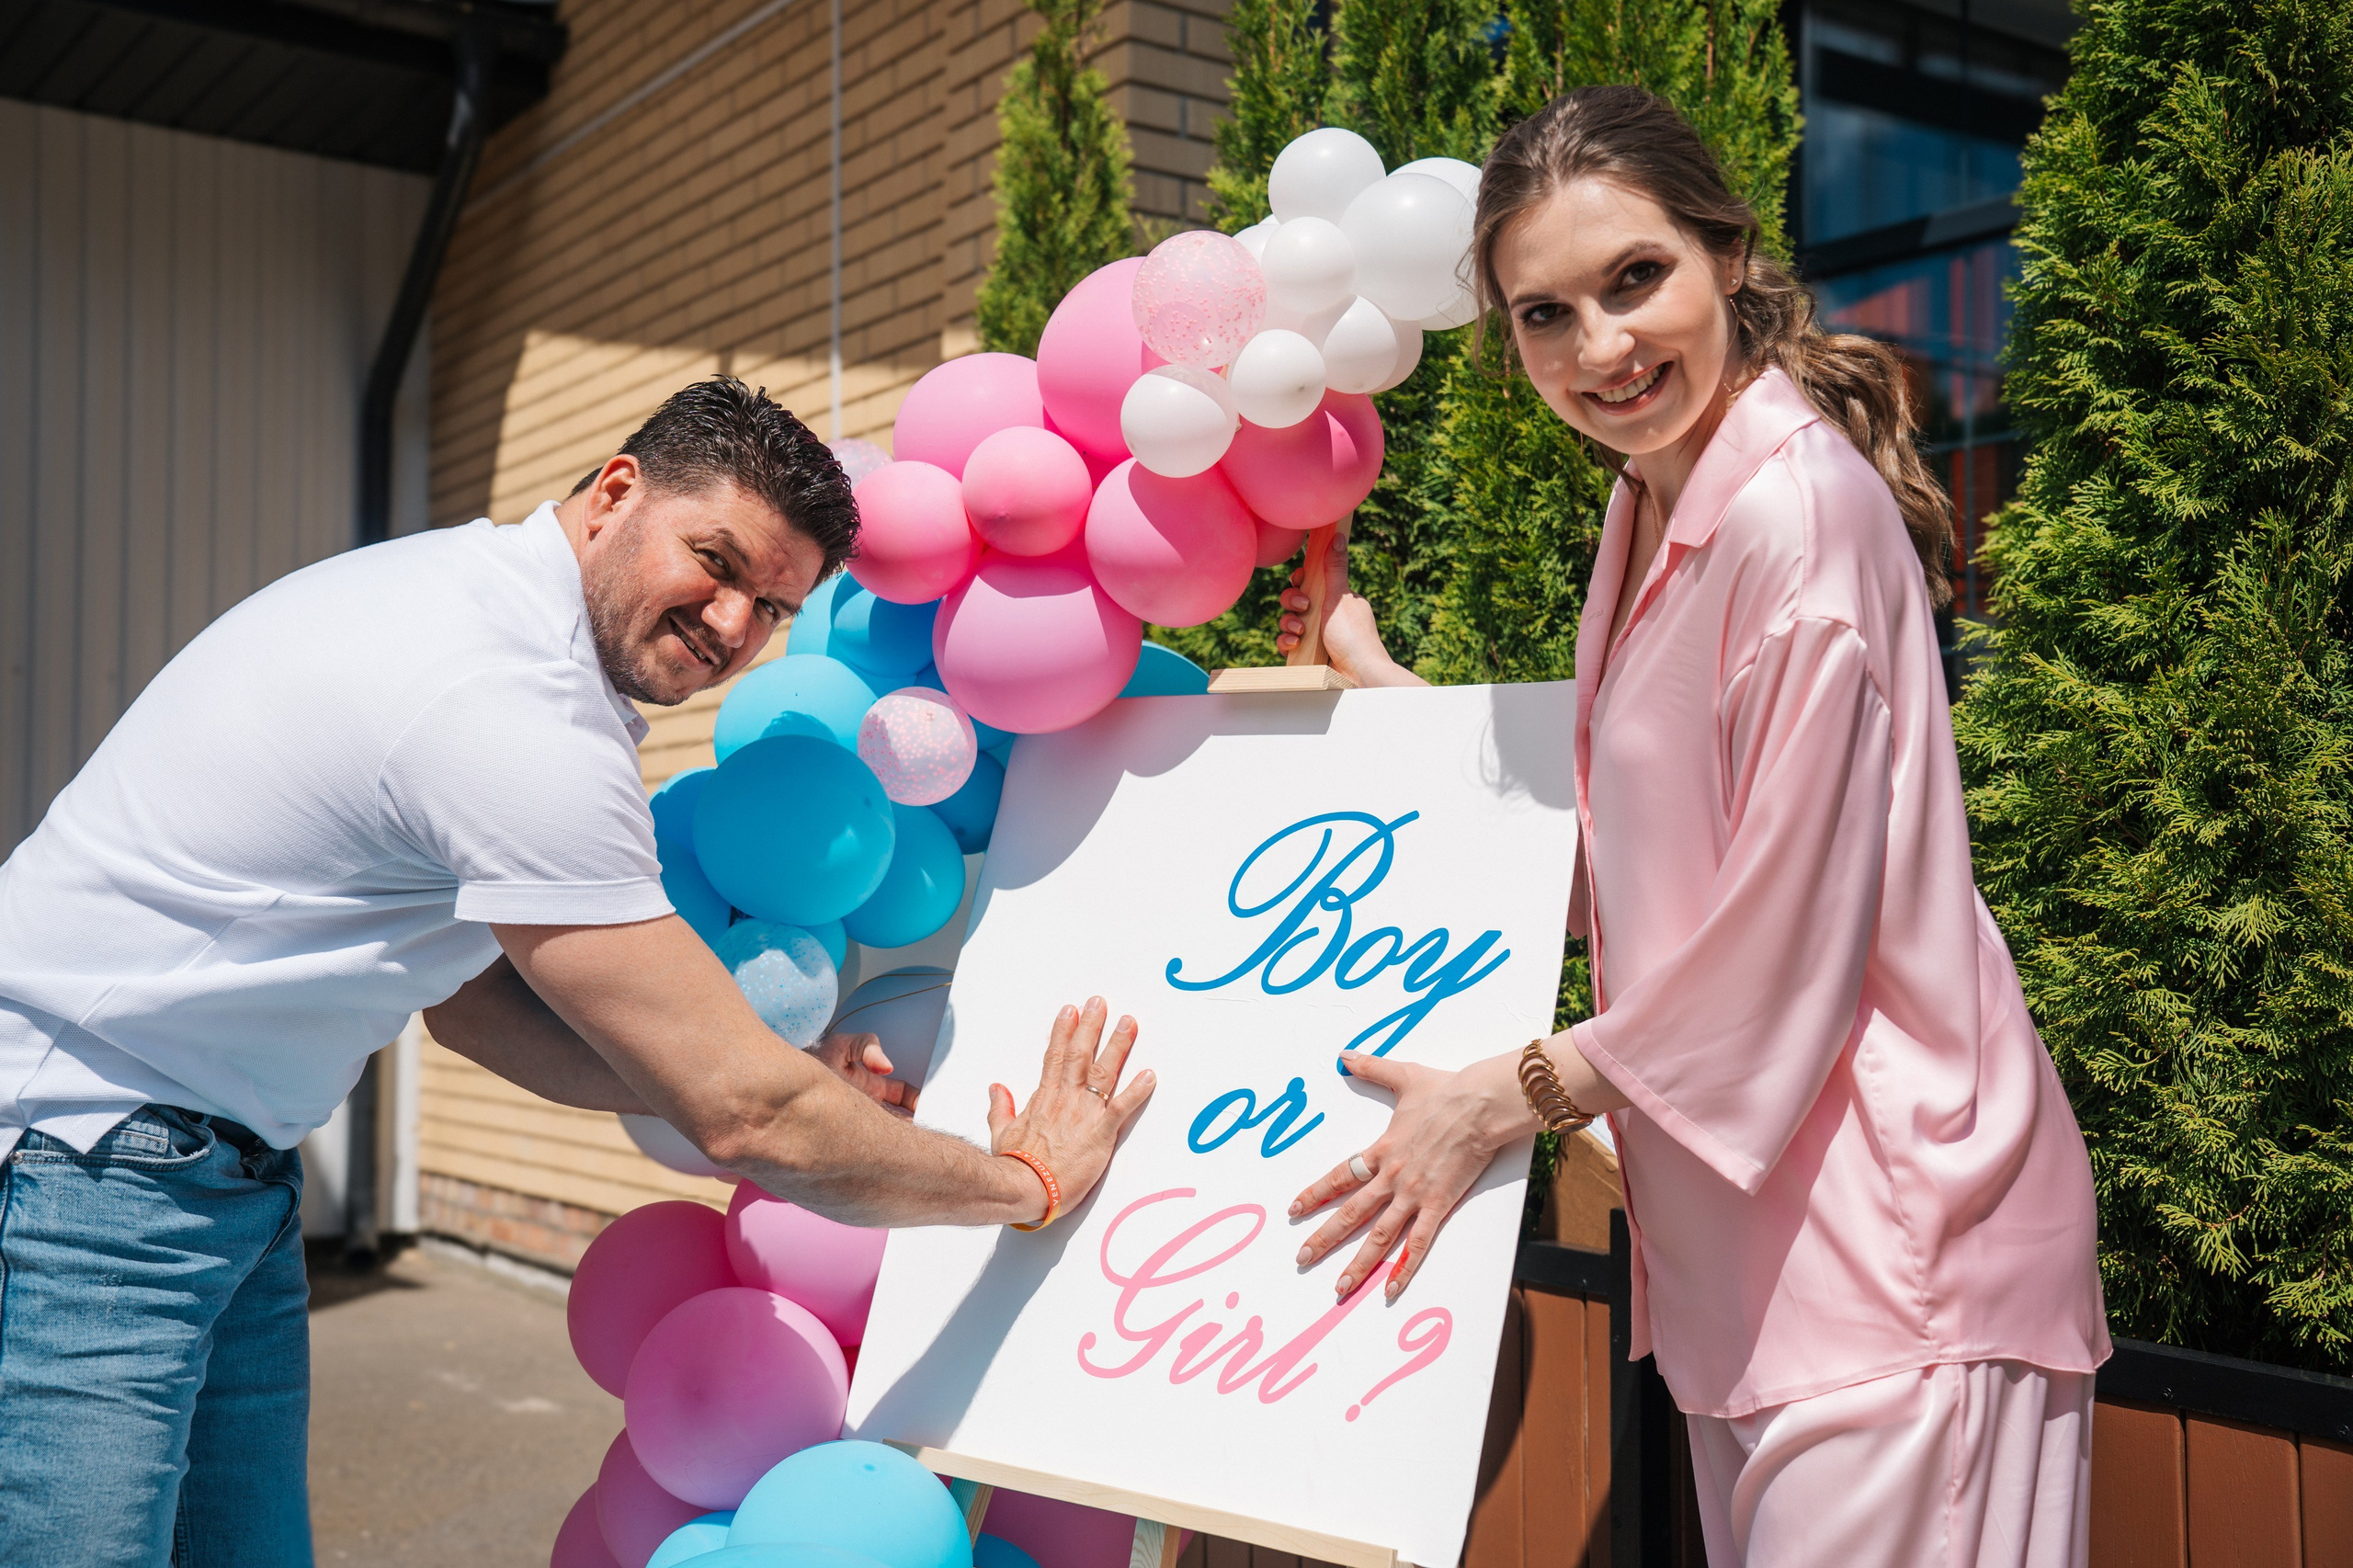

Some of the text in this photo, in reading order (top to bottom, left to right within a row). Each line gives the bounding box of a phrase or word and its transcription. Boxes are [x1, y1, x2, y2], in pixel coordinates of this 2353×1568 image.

[1165, 810, 1511, 1077] Boy
[1023, 1153, 1060, 1207] VENEZUELA
[1187, 1076, 1325, 1159] or
[1077, 1187, 1453, 1423] Girl ?
